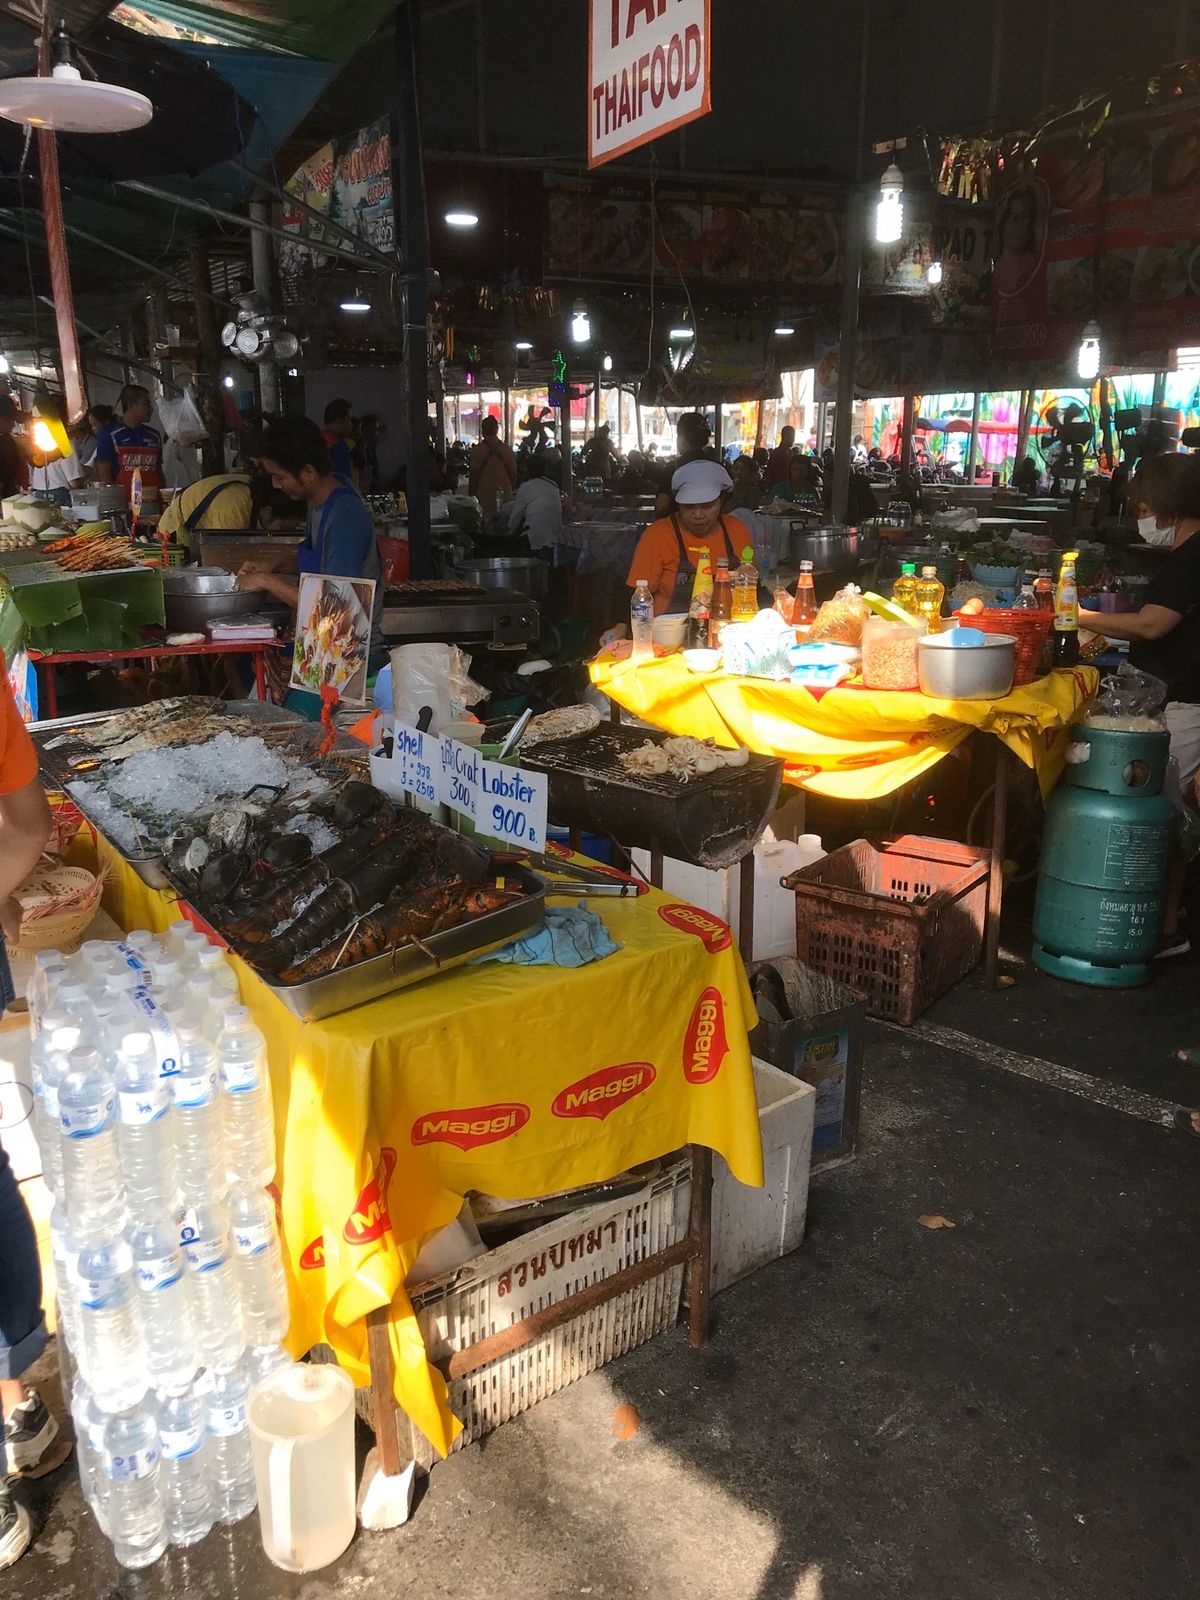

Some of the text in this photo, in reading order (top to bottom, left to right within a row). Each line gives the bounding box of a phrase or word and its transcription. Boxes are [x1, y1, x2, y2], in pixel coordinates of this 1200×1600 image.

[593, 23, 701, 140] THAIFOOD
[400, 770, 407, 786] 3
[450, 776, 470, 806] 300
[482, 767, 537, 804] Lobster
[492, 804, 526, 837] 900
[667, 907, 725, 943] Maggi
[690, 999, 718, 1073] Maggi
[565, 1068, 644, 1111] Maggi
[421, 1110, 517, 1138] Maggi
